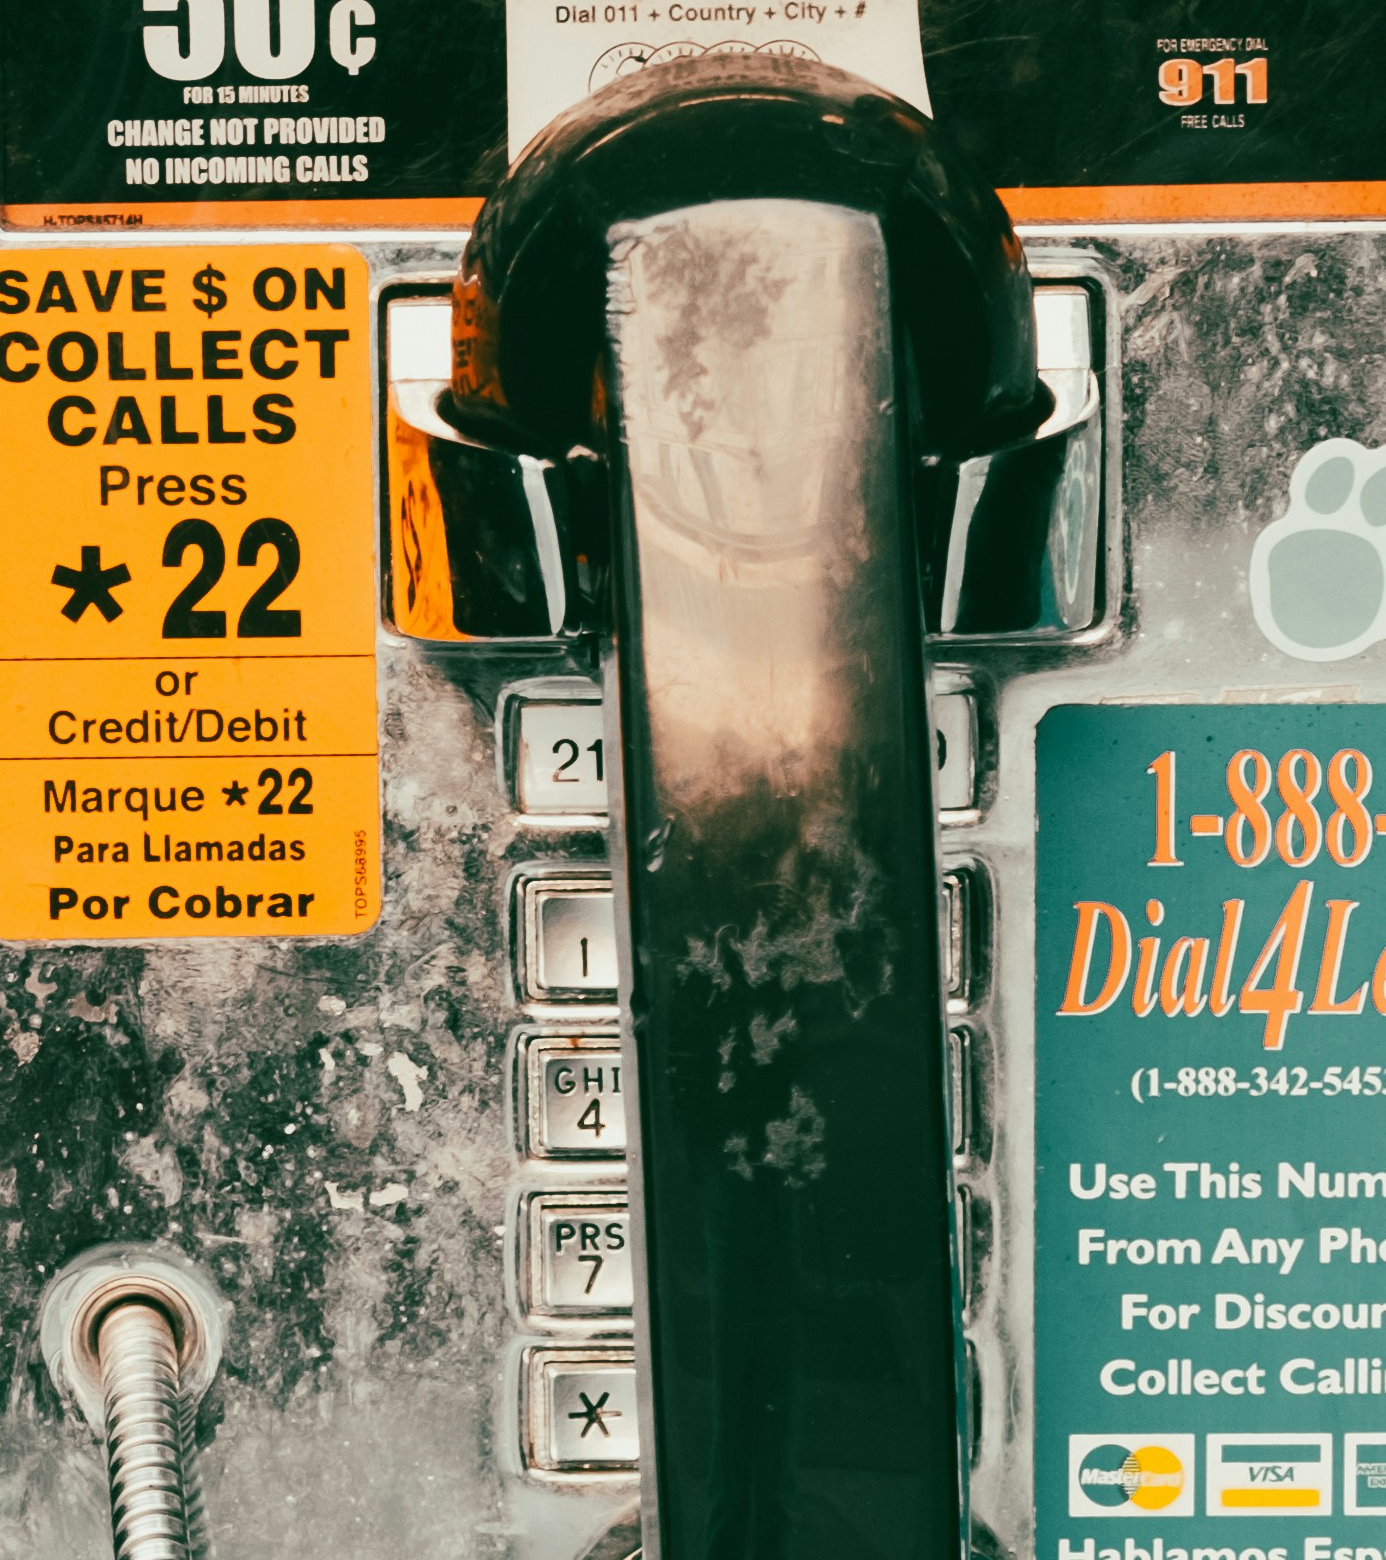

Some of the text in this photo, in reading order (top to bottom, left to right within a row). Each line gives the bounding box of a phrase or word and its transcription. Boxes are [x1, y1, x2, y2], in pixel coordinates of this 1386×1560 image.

[556, 1, 868, 25] Dial 011 + Country + City + #
[1157, 38, 1269, 53] FOR EMERGENCY DIAL
[183, 85, 310, 104] FOR 15 MINUTES
[1158, 58, 1268, 107] 911
[107, 117, 386, 147] CHANGE NOT PROVIDED
[1181, 114, 1245, 128] FREE CALLS
[126, 155, 369, 185] NO INCOMING CALLS
[193, 264, 228, 319] $
[252, 267, 345, 311] ON
[47, 393, 297, 447] CALLS
[100, 465, 247, 506] Press
[155, 670, 199, 697] or
[48, 708, 308, 745] Credit/Debit
[551, 737, 604, 784] 21
[44, 779, 204, 821] Marque
[54, 831, 306, 863] Para Llamadas
[49, 885, 315, 920] Por Cobrar
[576, 1099, 606, 1138] 4
[1069, 1164, 1156, 1200] Use
[1163, 1162, 1262, 1199] This
[556, 1223, 625, 1253] PRS
[1078, 1228, 1201, 1265] From
[1211, 1228, 1304, 1275] Any
[578, 1255, 603, 1295] 7
[1121, 1294, 1201, 1331] For
[1100, 1358, 1266, 1396] Collect
[1080, 1468, 1183, 1487] MasterCard
[1249, 1466, 1296, 1482] VISA
